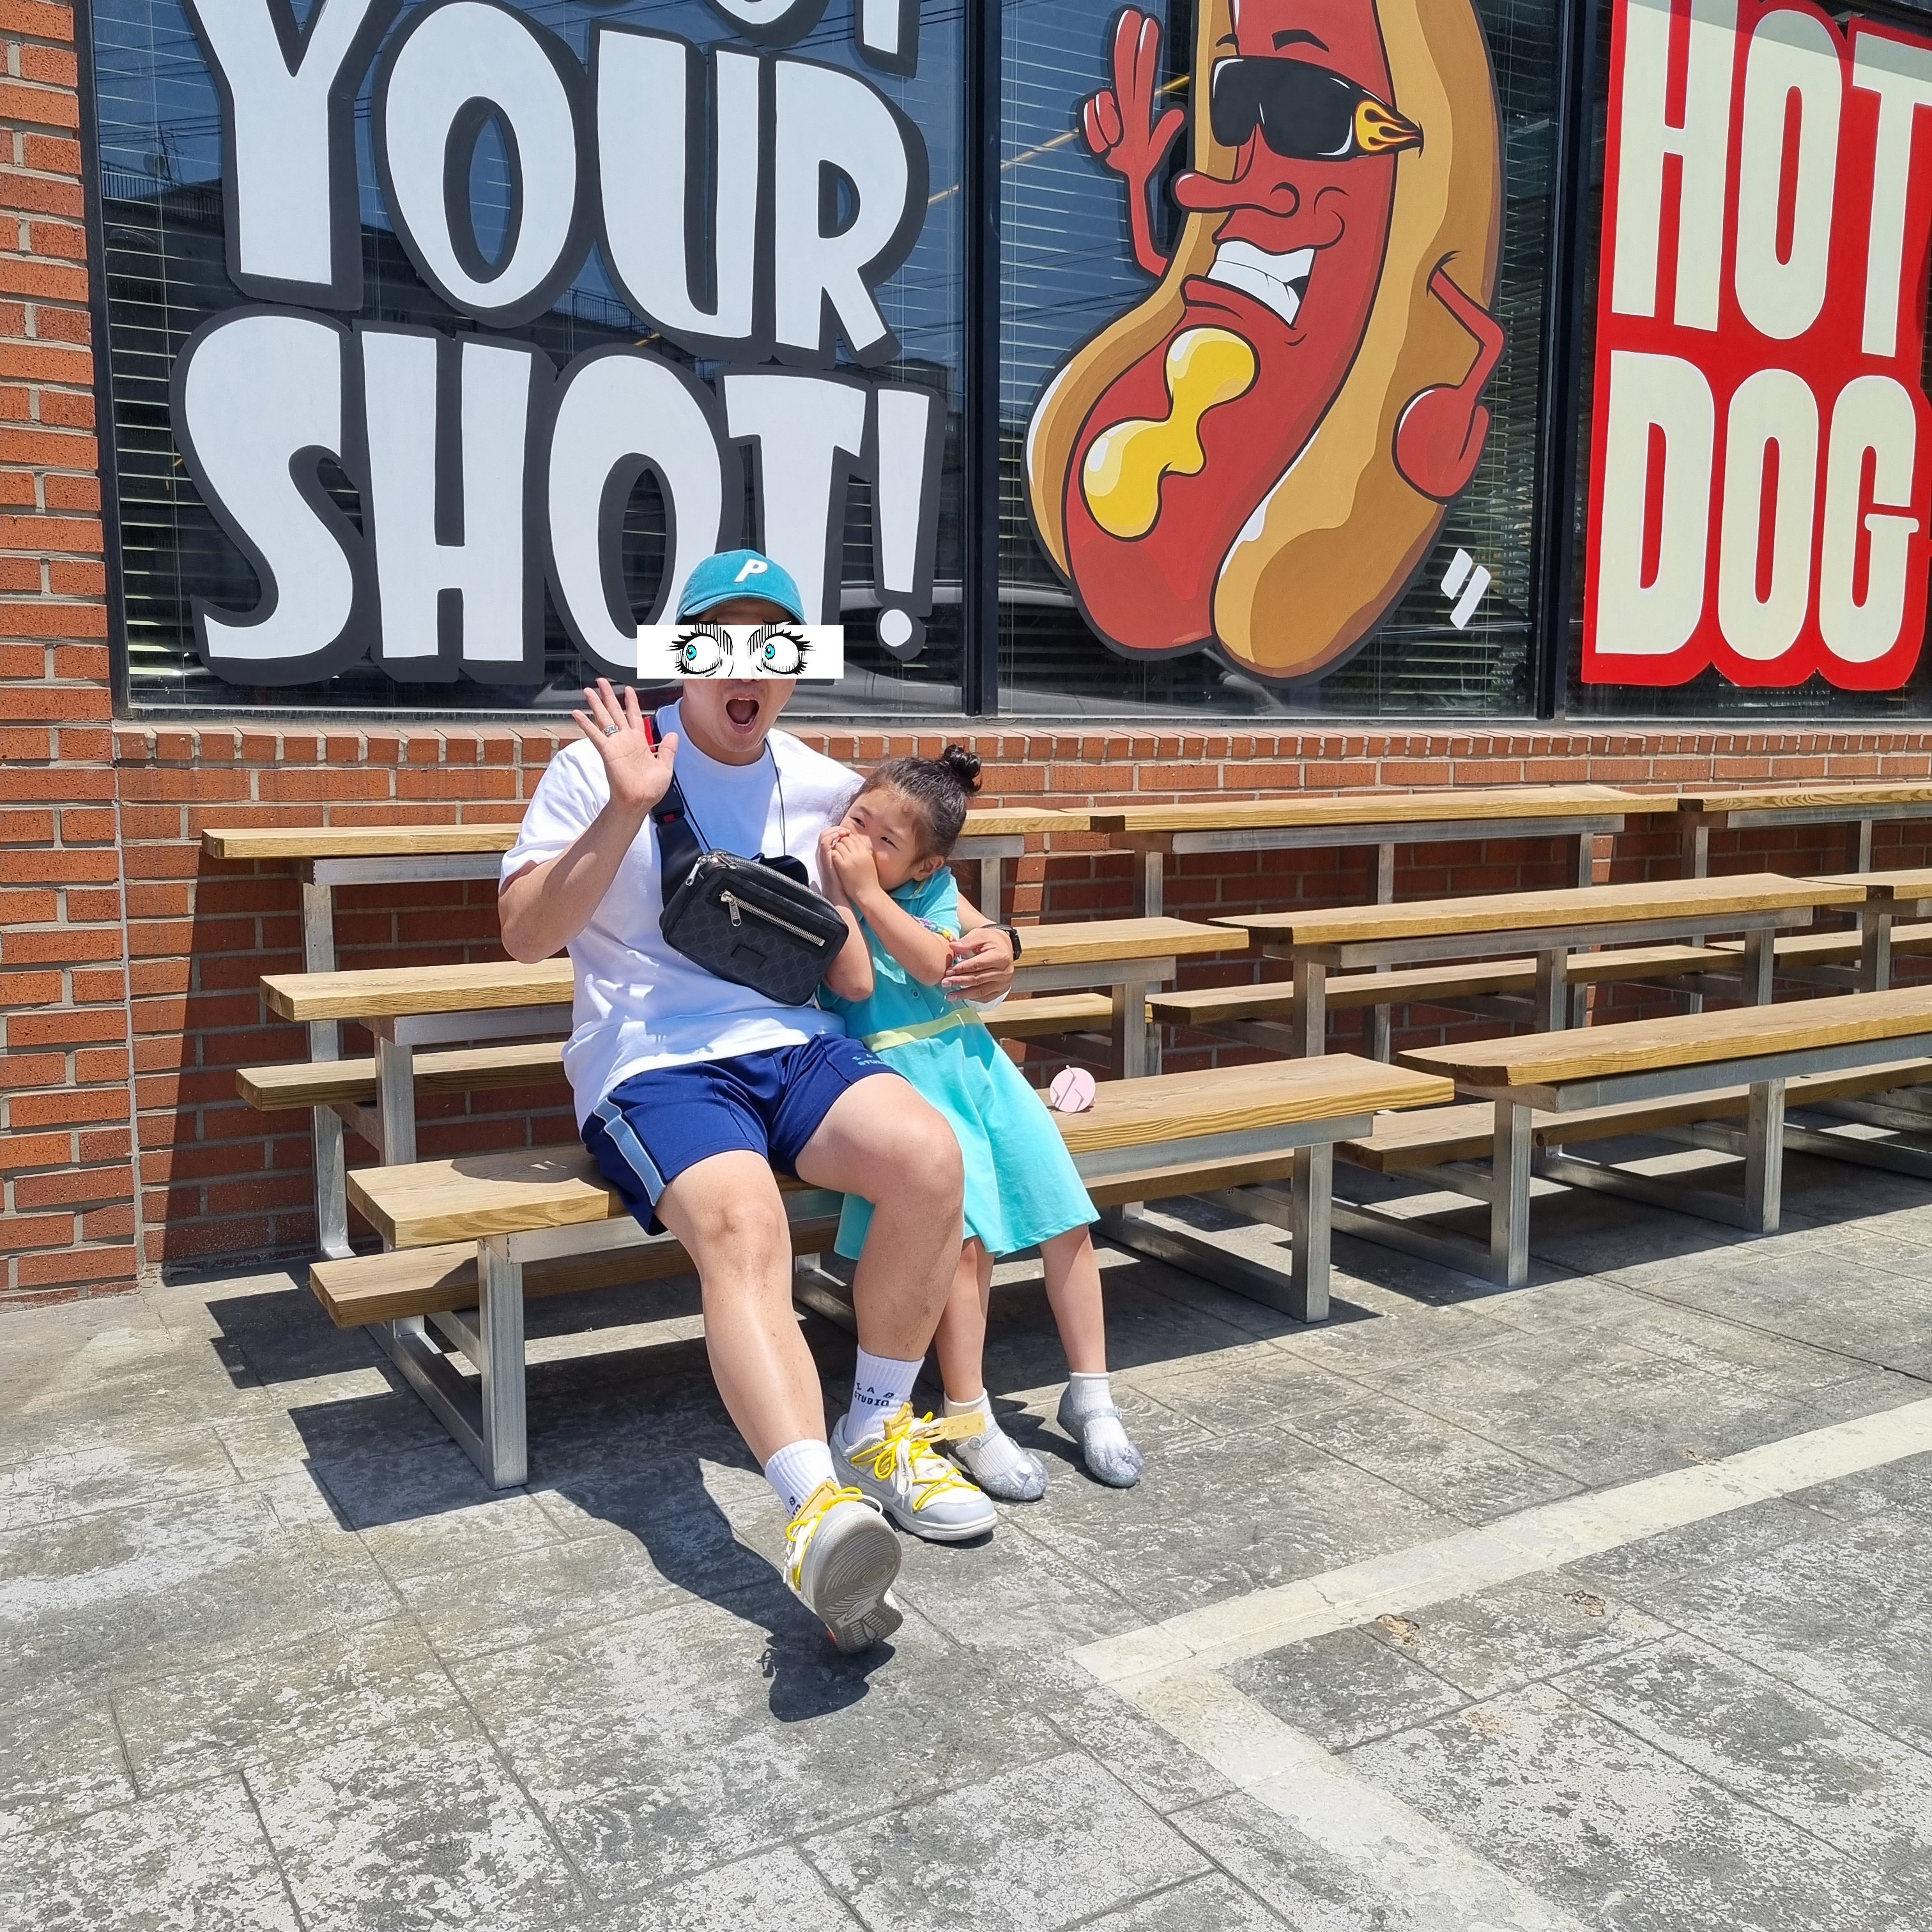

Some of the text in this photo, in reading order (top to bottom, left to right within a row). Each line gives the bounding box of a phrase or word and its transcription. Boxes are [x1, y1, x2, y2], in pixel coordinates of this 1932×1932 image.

[194, 0, 909, 352] YOUR
[1612, 0, 1932, 358] HOT
[185, 316, 930, 668] SHOT!
[733, 558, 769, 583] P
[1595, 349, 1920, 663] DOG
